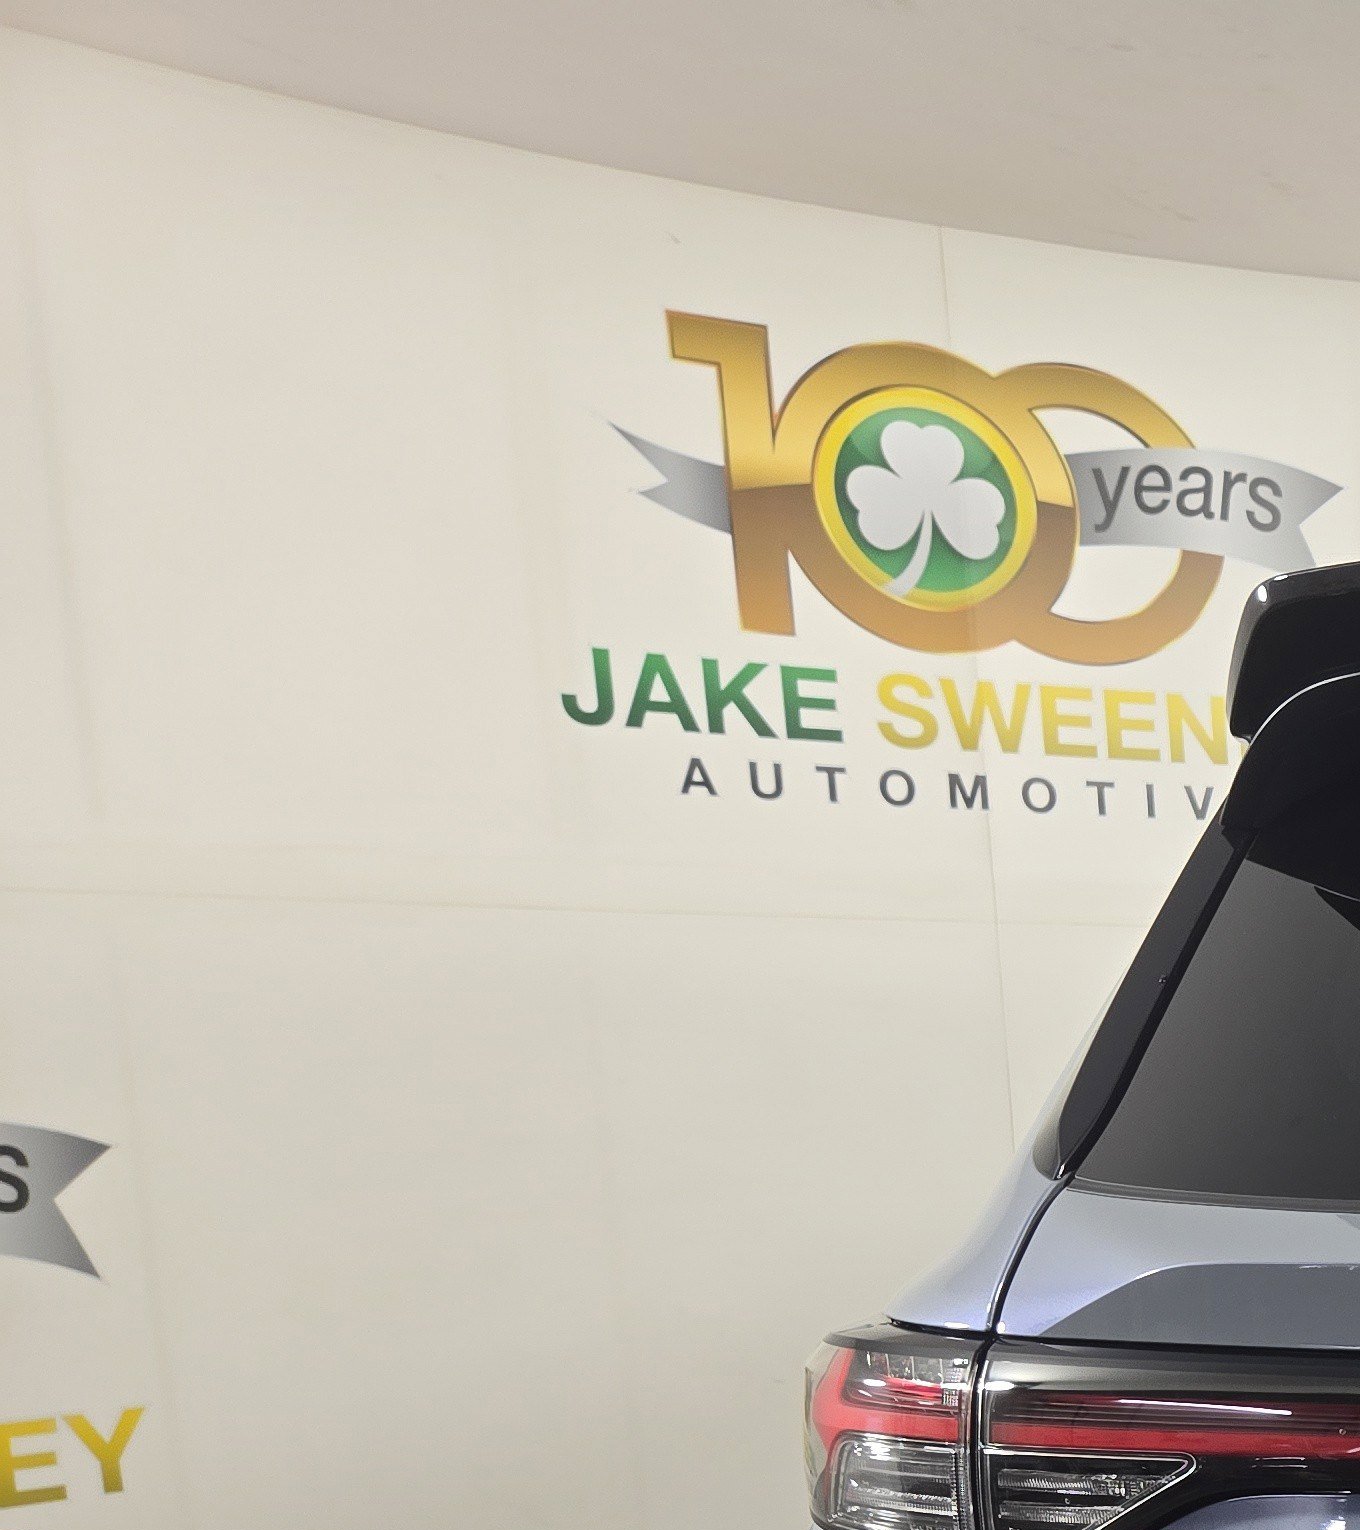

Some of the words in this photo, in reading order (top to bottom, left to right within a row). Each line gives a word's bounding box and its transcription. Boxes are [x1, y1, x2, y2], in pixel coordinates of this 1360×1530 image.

[665, 309, 1224, 665] 100
[1091, 460, 1284, 535] years
[562, 646, 844, 743] JAKE
[876, 671, 1248, 765] SWEEN
[681, 757, 1214, 821] AUTOMOTIV
